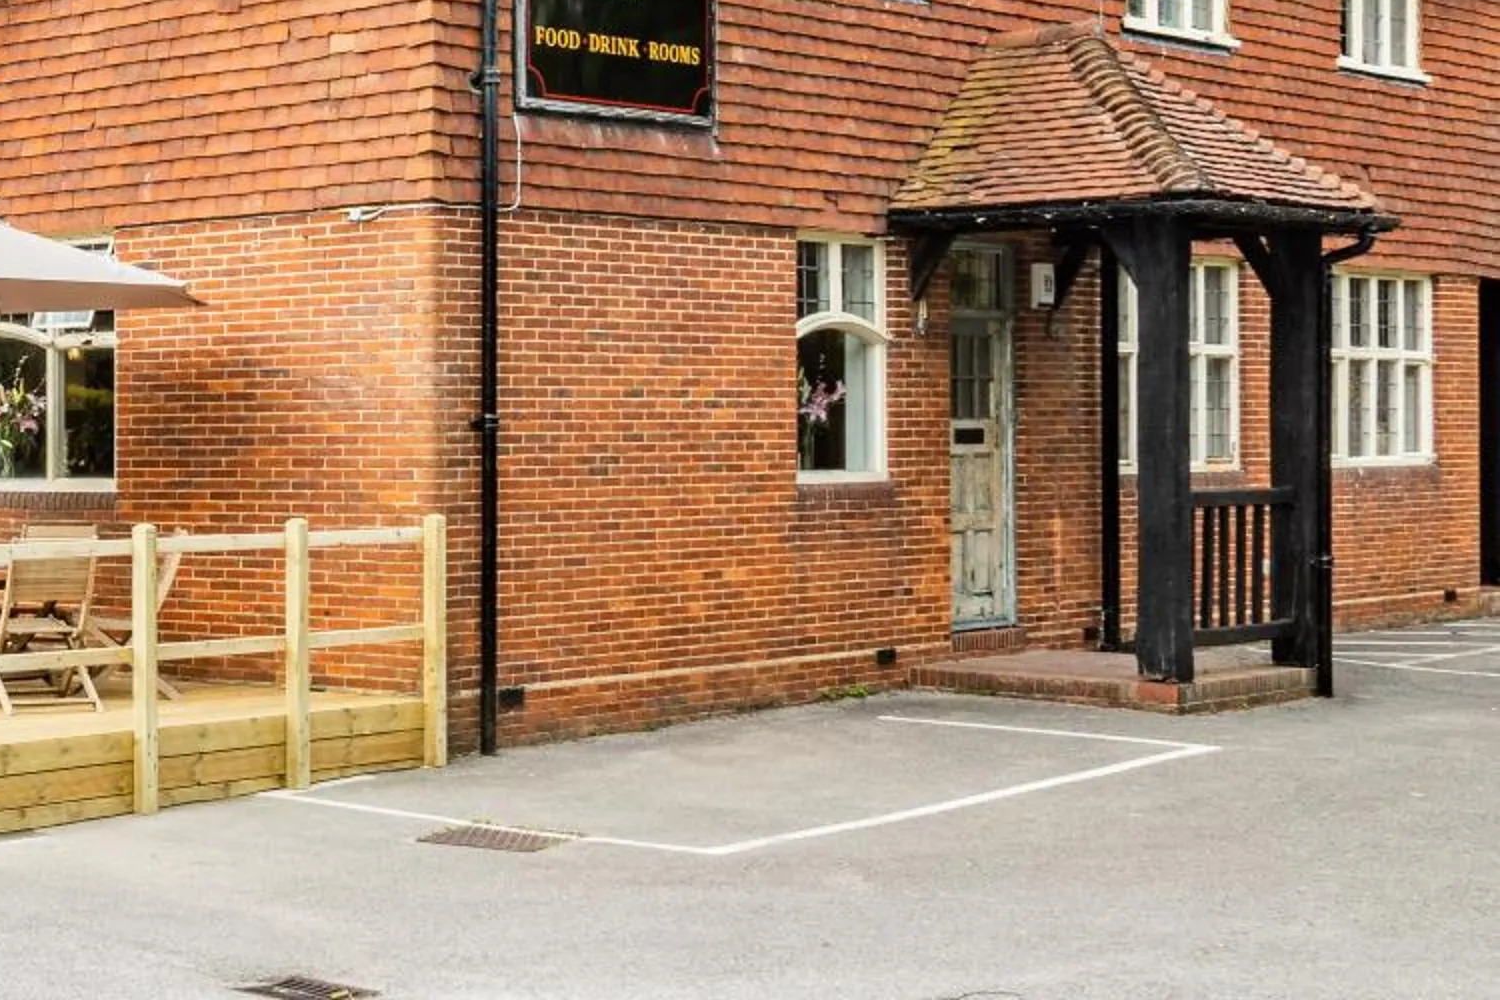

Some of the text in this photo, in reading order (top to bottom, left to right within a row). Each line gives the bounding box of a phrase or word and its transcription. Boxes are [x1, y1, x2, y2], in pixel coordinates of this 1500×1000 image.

[534, 24, 701, 66] FOOD DRINK ROOMS
